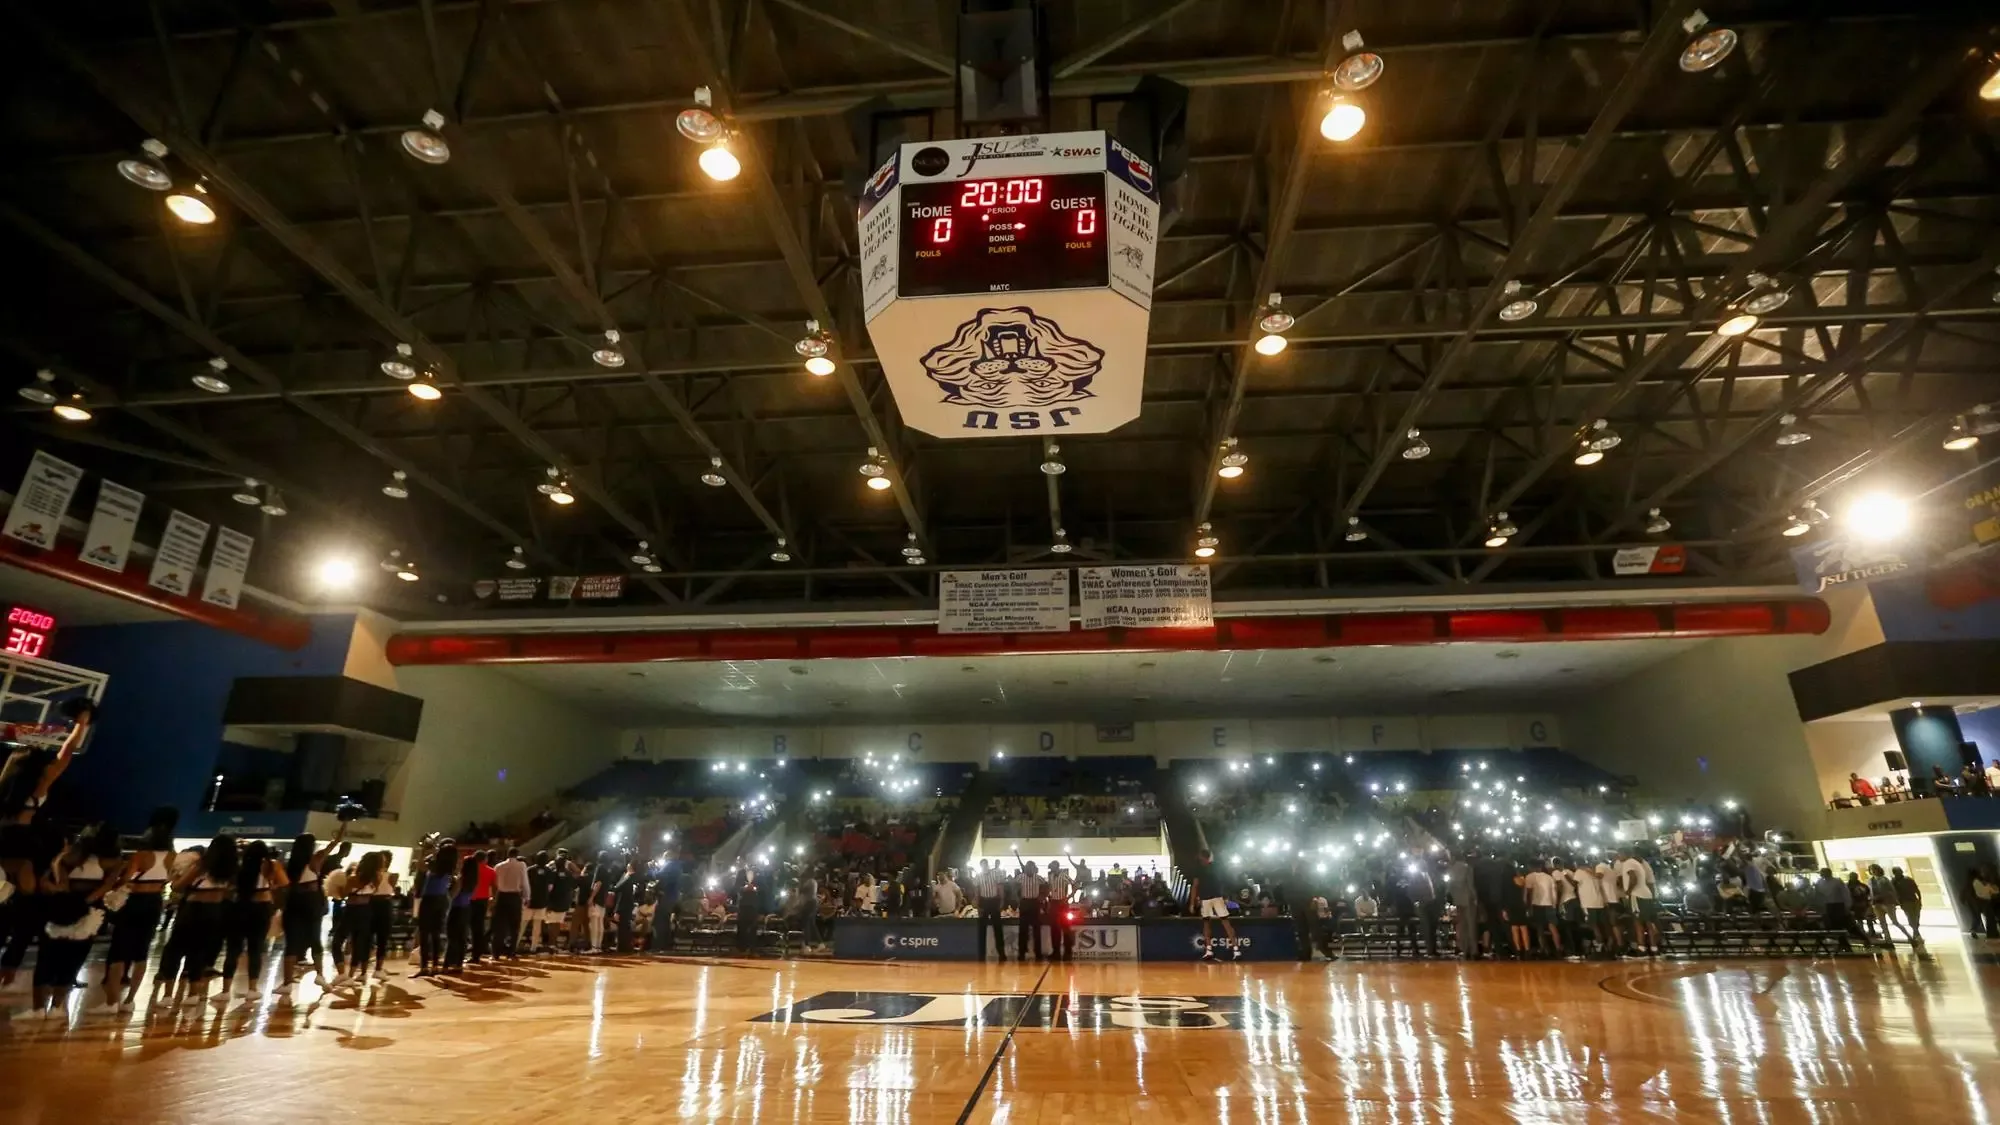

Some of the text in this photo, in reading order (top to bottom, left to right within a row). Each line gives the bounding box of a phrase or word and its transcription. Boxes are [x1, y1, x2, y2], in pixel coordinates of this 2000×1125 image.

[956, 140, 1010, 178] JSU
[1063, 147, 1101, 157] SWAC
[1112, 139, 1153, 175] PEPSI
[961, 179, 1043, 207] 20:00
[1117, 189, 1151, 215] HOME
[912, 206, 953, 218] HOME
[987, 206, 1017, 214] PERIOD
[1050, 197, 1096, 210] GUEST
[866, 204, 891, 232] HOME
[1077, 209, 1096, 234] 0
[1114, 200, 1152, 230] OF THE
[933, 217, 953, 243] 0
[989, 234, 1015, 242] BONUS
[915, 250, 942, 258] FOULS
[988, 246, 1017, 254] PLAYER
[1065, 241, 1092, 249] FOULS
[962, 407, 1082, 430] JSU
[1009, 572, 1028, 580] Golf
[1111, 566, 1178, 578] Women's Golf
[1815, 562, 1909, 593] JSU TIGERS
[1081, 579, 1208, 589] SWAC Conference Championship
[8, 608, 54, 629] 20:00
[1107, 606, 1129, 614] NCAA
[6, 627, 45, 657] 30
[1040, 731, 1054, 751] D
[1213, 727, 1226, 747] E
[1372, 725, 1384, 745] F
[1530, 720, 1548, 742] G
[634, 734, 647, 755] A
[774, 735, 786, 753] B
[908, 732, 922, 751] C
